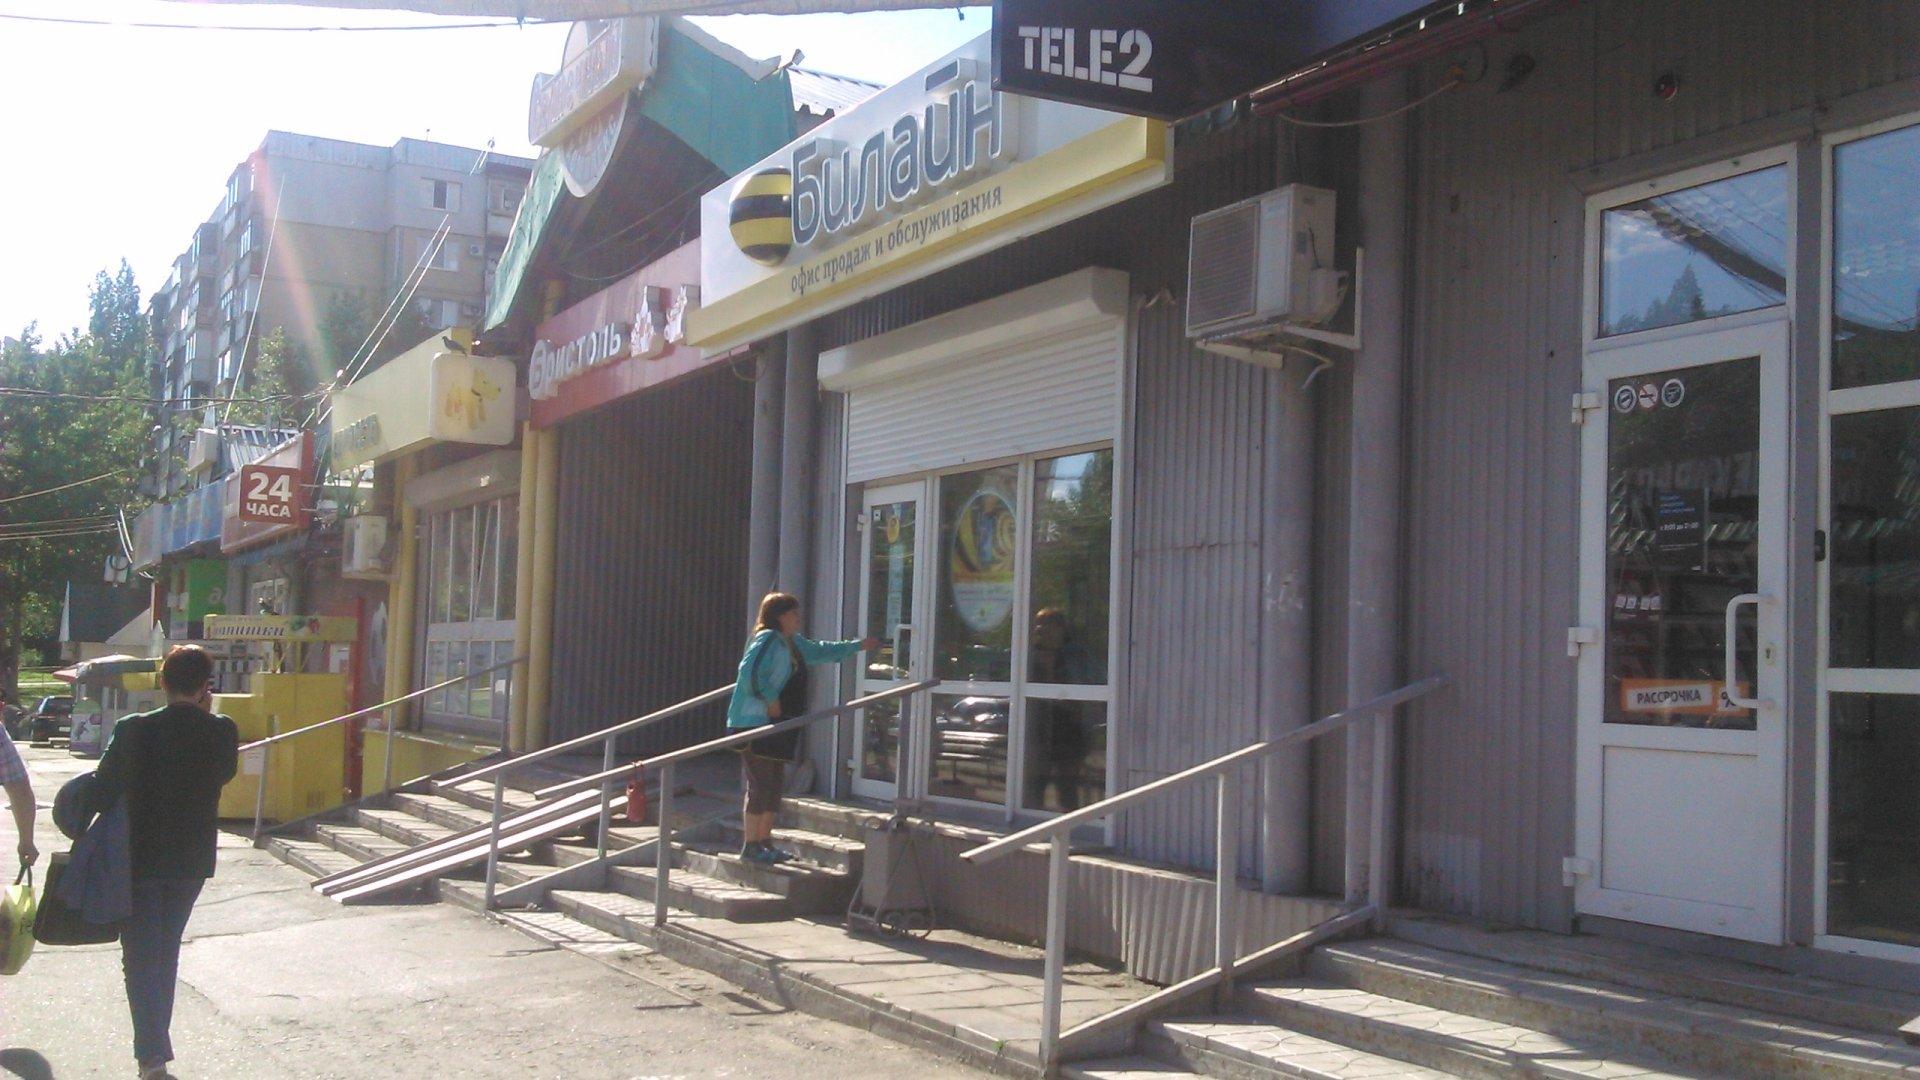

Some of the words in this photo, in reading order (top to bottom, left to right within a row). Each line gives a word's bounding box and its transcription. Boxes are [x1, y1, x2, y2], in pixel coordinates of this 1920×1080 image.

[1018, 26, 1153, 93] TELE2
[791, 58, 1002, 246] Билайн
[791, 266, 821, 296] офис
[823, 241, 872, 283] продаж
[874, 239, 884, 256] и
[887, 185, 1002, 250] обслуживания
[246, 502, 291, 518] ЧАСА
[248, 471, 293, 502] 24
[1637, 689, 1702, 705] РАССРОЧКА
